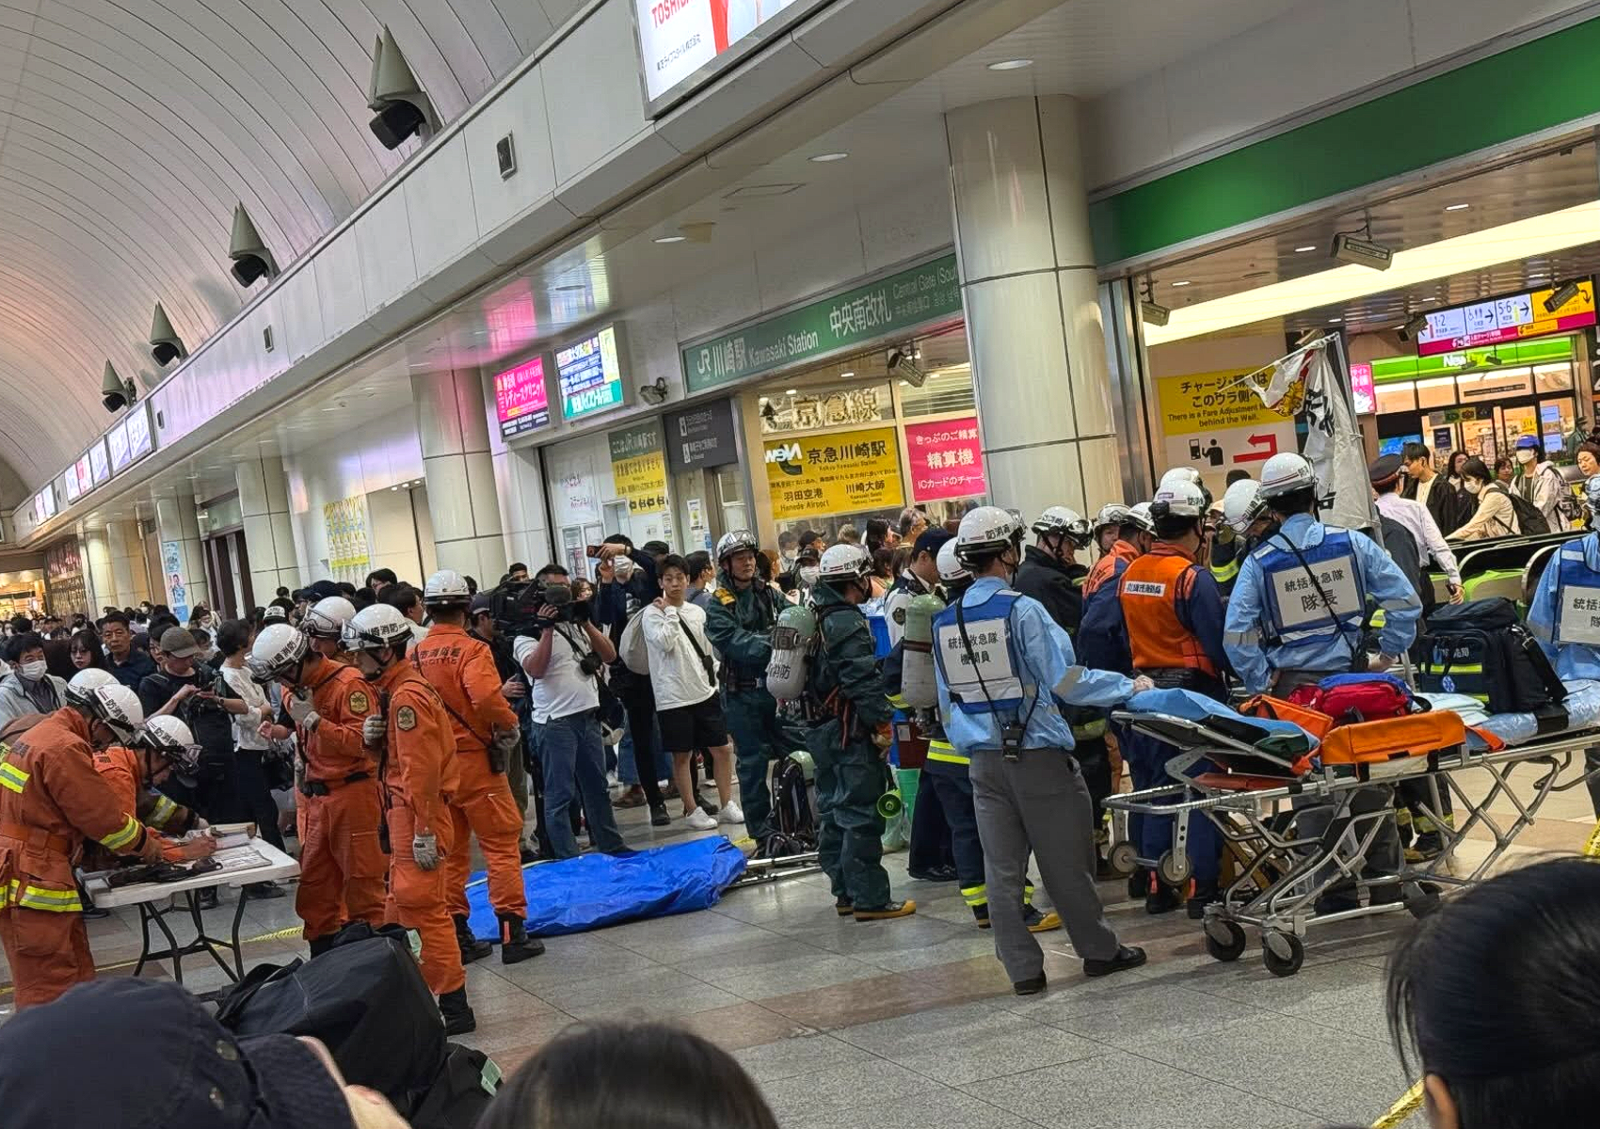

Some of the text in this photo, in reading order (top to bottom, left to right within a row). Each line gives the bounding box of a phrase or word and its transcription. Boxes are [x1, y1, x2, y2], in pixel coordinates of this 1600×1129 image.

[652, 0, 689, 28] TOSHI
[829, 288, 892, 338] 中央南改札
[748, 330, 819, 368] Kawasaki Station
[1181, 372, 1267, 394] チャージ・精は
[1168, 413, 1188, 421] There
[1203, 409, 1218, 417] Fare
[1220, 404, 1257, 415] Adjustment
[1199, 418, 1225, 427] behind
[1226, 416, 1239, 424] the
[806, 440, 887, 465] 京急川崎駅
[927, 448, 974, 469] 精算機
[784, 488, 823, 501] 羽田空港
[846, 480, 885, 493] 川崎大師
[780, 499, 830, 512] Haneda Airport
[1300, 589, 1338, 612] 隊長
[1573, 597, 1600, 611] 統括
